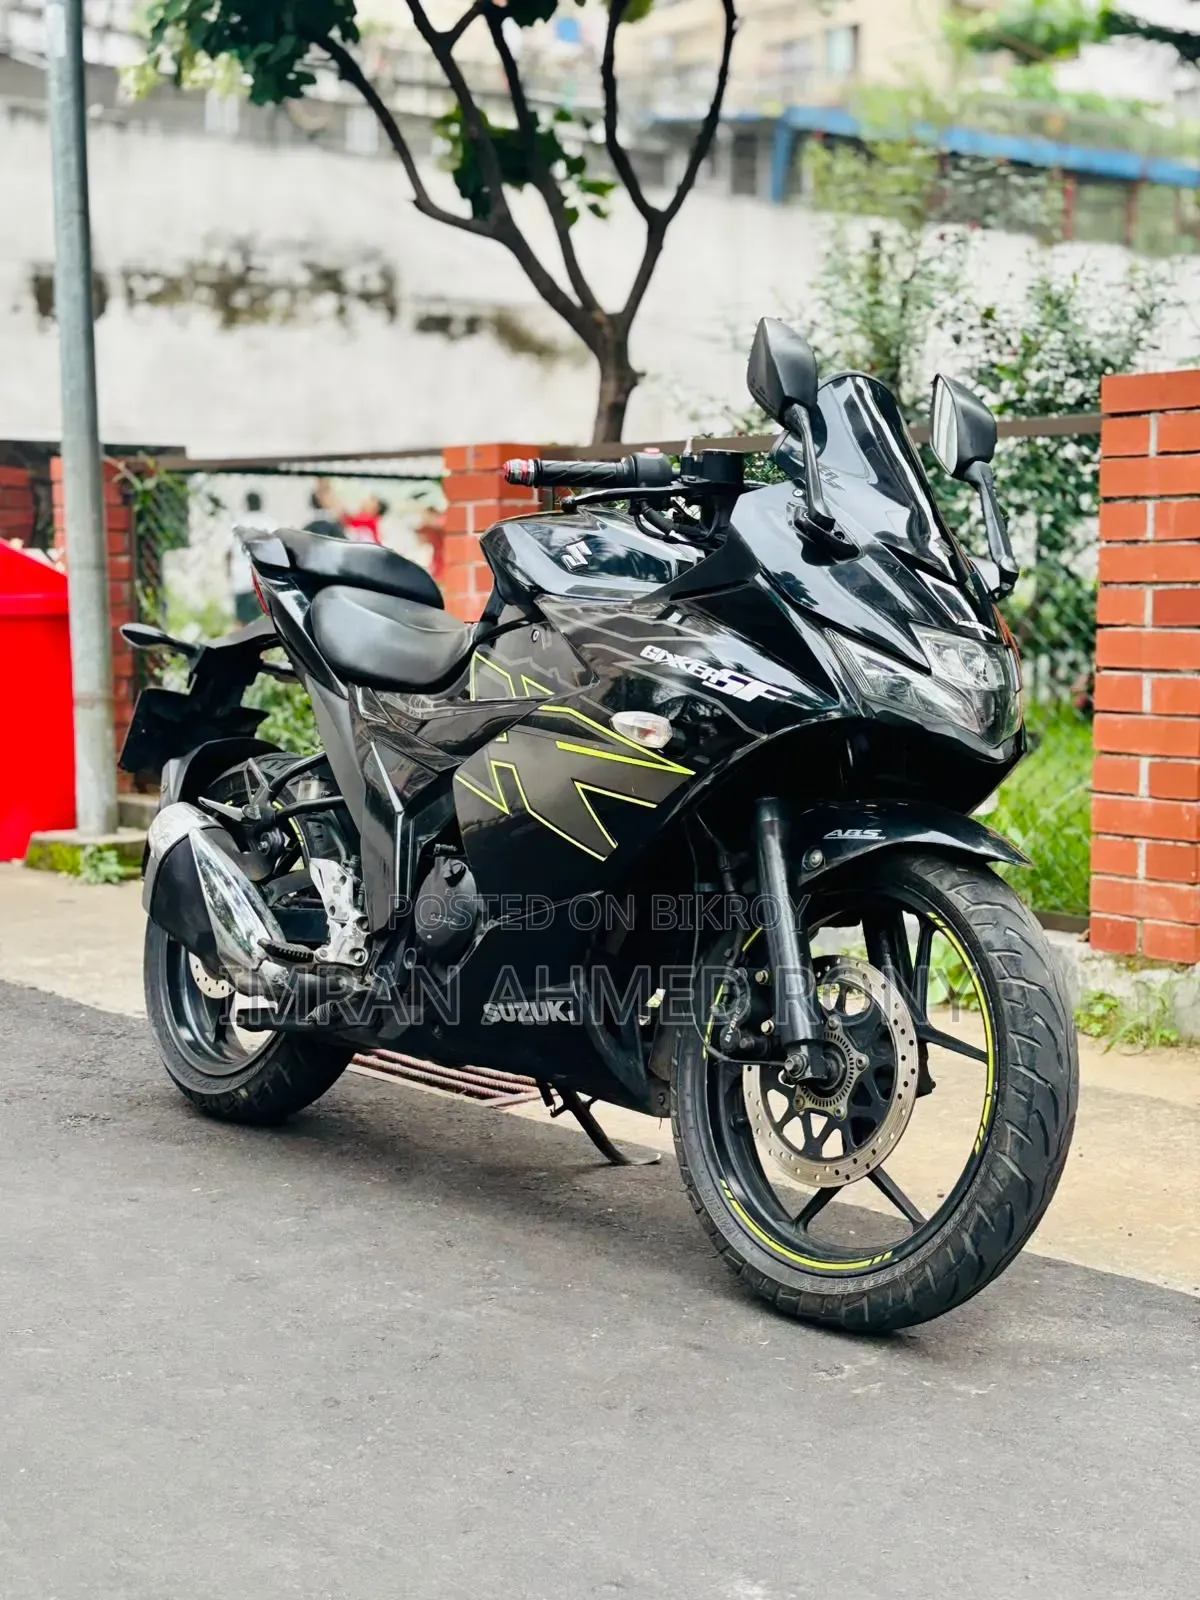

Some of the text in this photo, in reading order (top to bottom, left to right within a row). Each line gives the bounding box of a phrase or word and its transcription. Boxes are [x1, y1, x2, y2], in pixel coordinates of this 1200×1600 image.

[640, 645, 792, 702] GIXXER SF
[822, 829, 886, 840] ABS
[482, 1001, 576, 1022] SUZUKI
